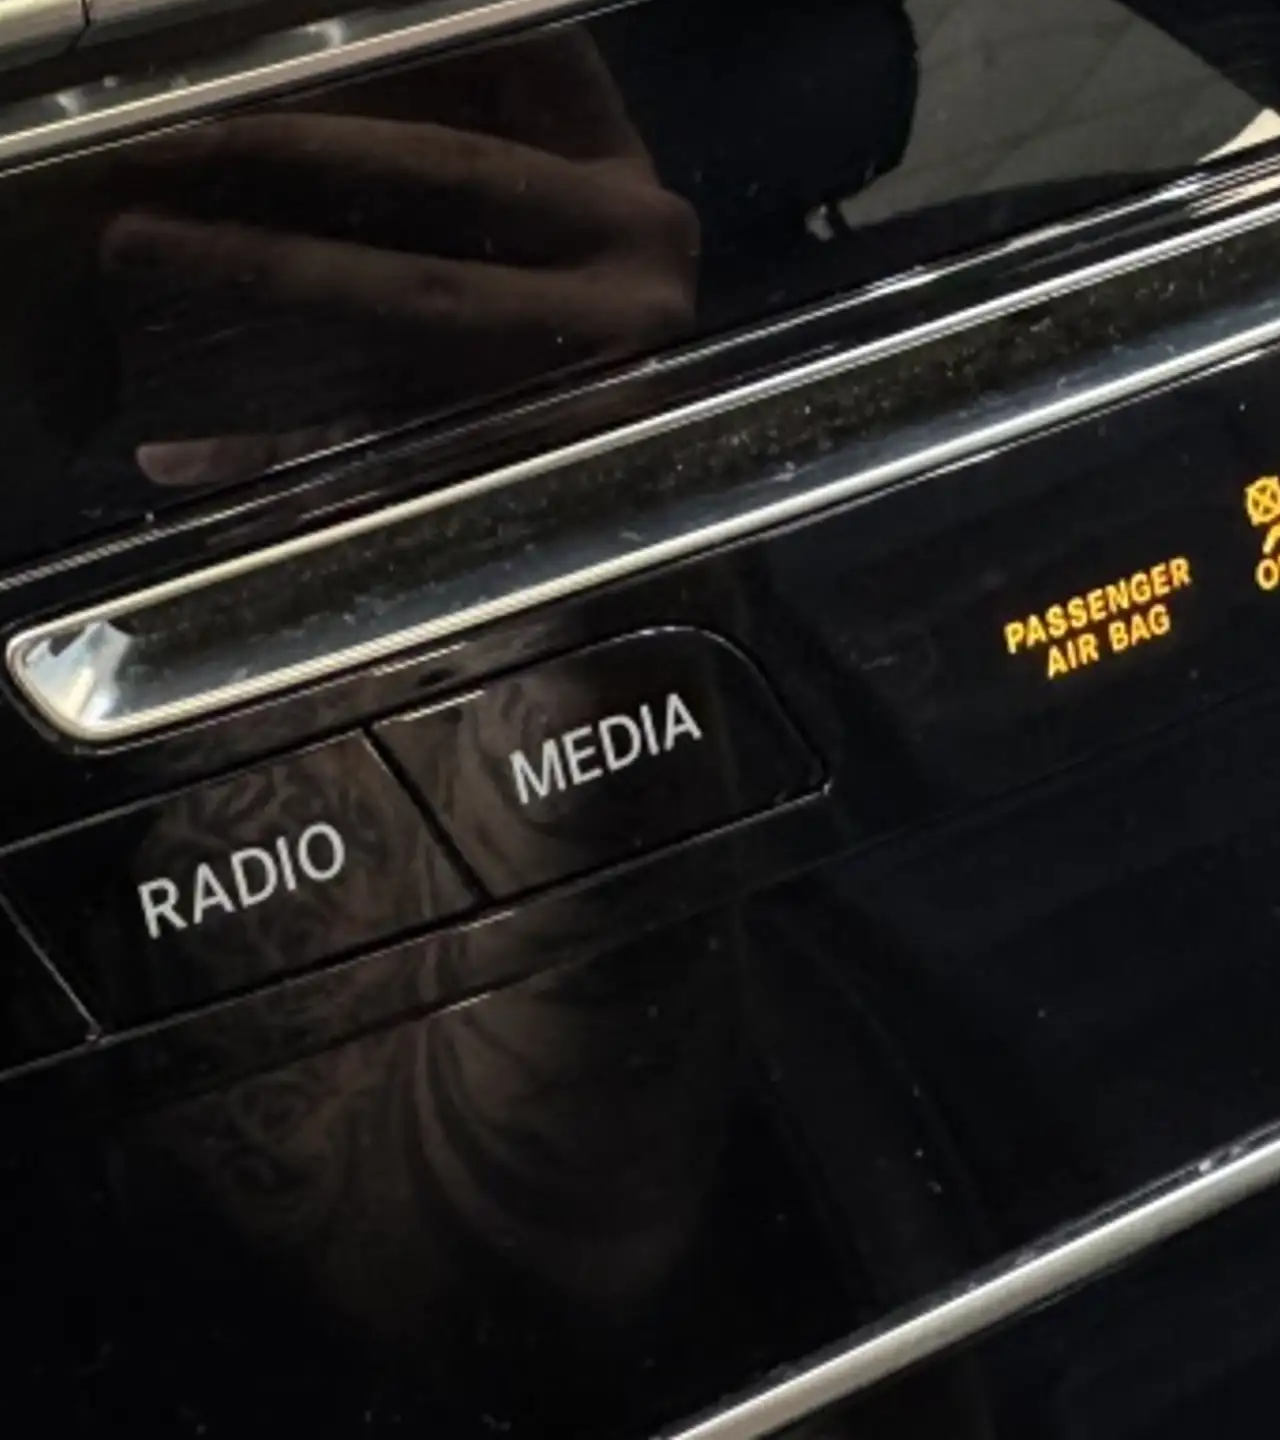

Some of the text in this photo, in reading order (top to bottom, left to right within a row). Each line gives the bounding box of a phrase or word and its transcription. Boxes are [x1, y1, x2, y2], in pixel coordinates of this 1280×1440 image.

[1004, 557, 1193, 655] PASSENGER
[1046, 604, 1171, 680] AIR BAG
[507, 691, 704, 807] MEDIA
[137, 821, 346, 939] RADIO
